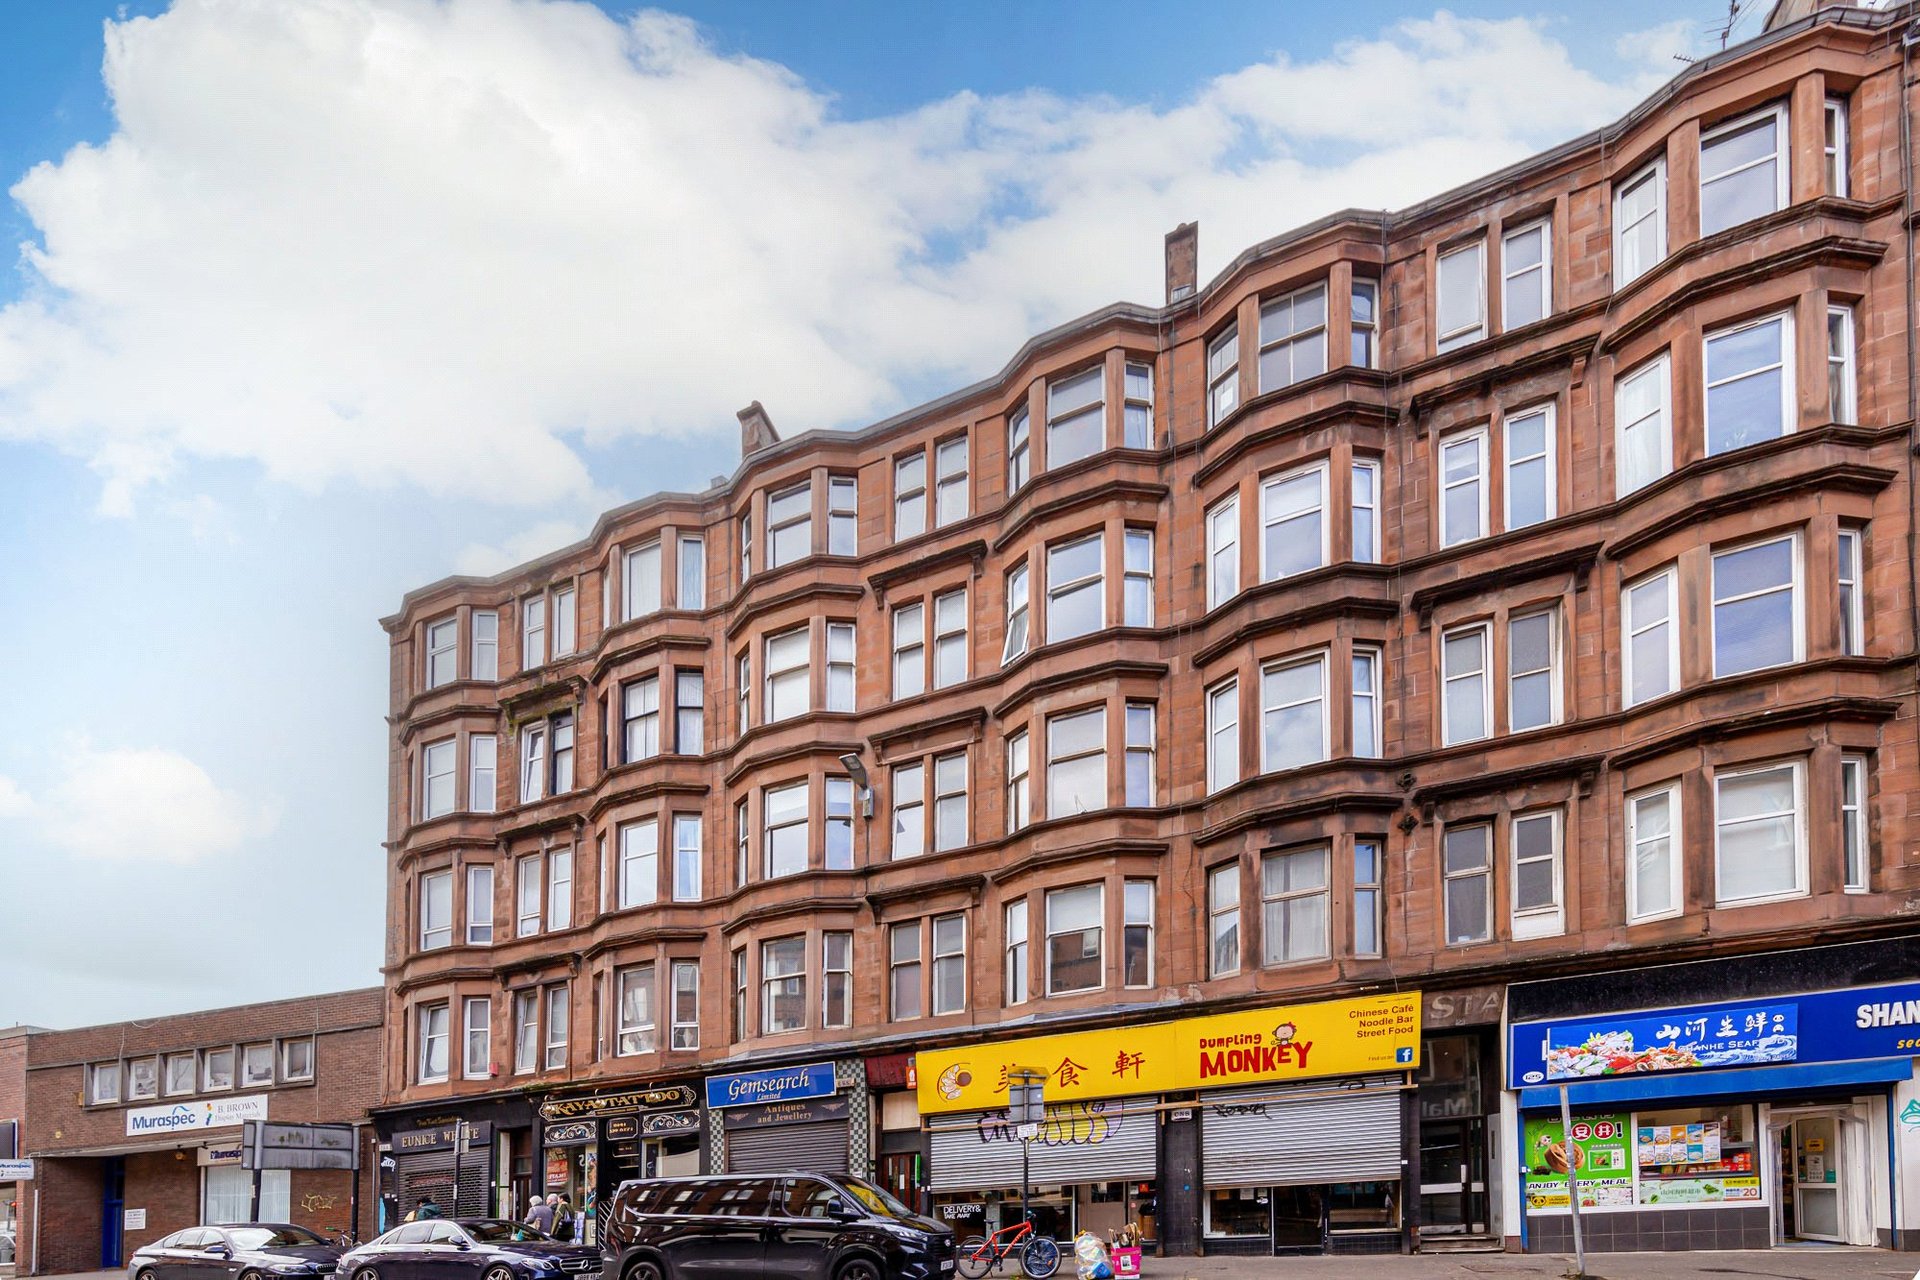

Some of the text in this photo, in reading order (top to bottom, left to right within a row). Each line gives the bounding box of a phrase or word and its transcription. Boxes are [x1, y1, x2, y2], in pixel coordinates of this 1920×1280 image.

[1349, 1004, 1414, 1018] Chinese Café
[1359, 1015, 1414, 1028] Noodle Bar
[1356, 1025, 1414, 1038] Street Food
[1728, 1038, 1785, 1049] SEAFD
[1200, 1041, 1313, 1079] MONKEY
[728, 1067, 810, 1101] Gemsearch
[555, 1099, 601, 1115] KAYA
[604, 1090, 680, 1107] TATTOO
[756, 1091, 781, 1101] Limited
[226, 1101, 258, 1112] BROWN
[764, 1103, 806, 1114] Antiques
[132, 1113, 196, 1130] Muraspec
[757, 1111, 813, 1124] and Jewellery
[402, 1133, 437, 1148] EUNICE
[443, 1127, 480, 1141] WHTE
[211, 1149, 242, 1160] Murasp
[1743, 1187, 1757, 1197] 20
[943, 1204, 981, 1214] DELIVERY&
